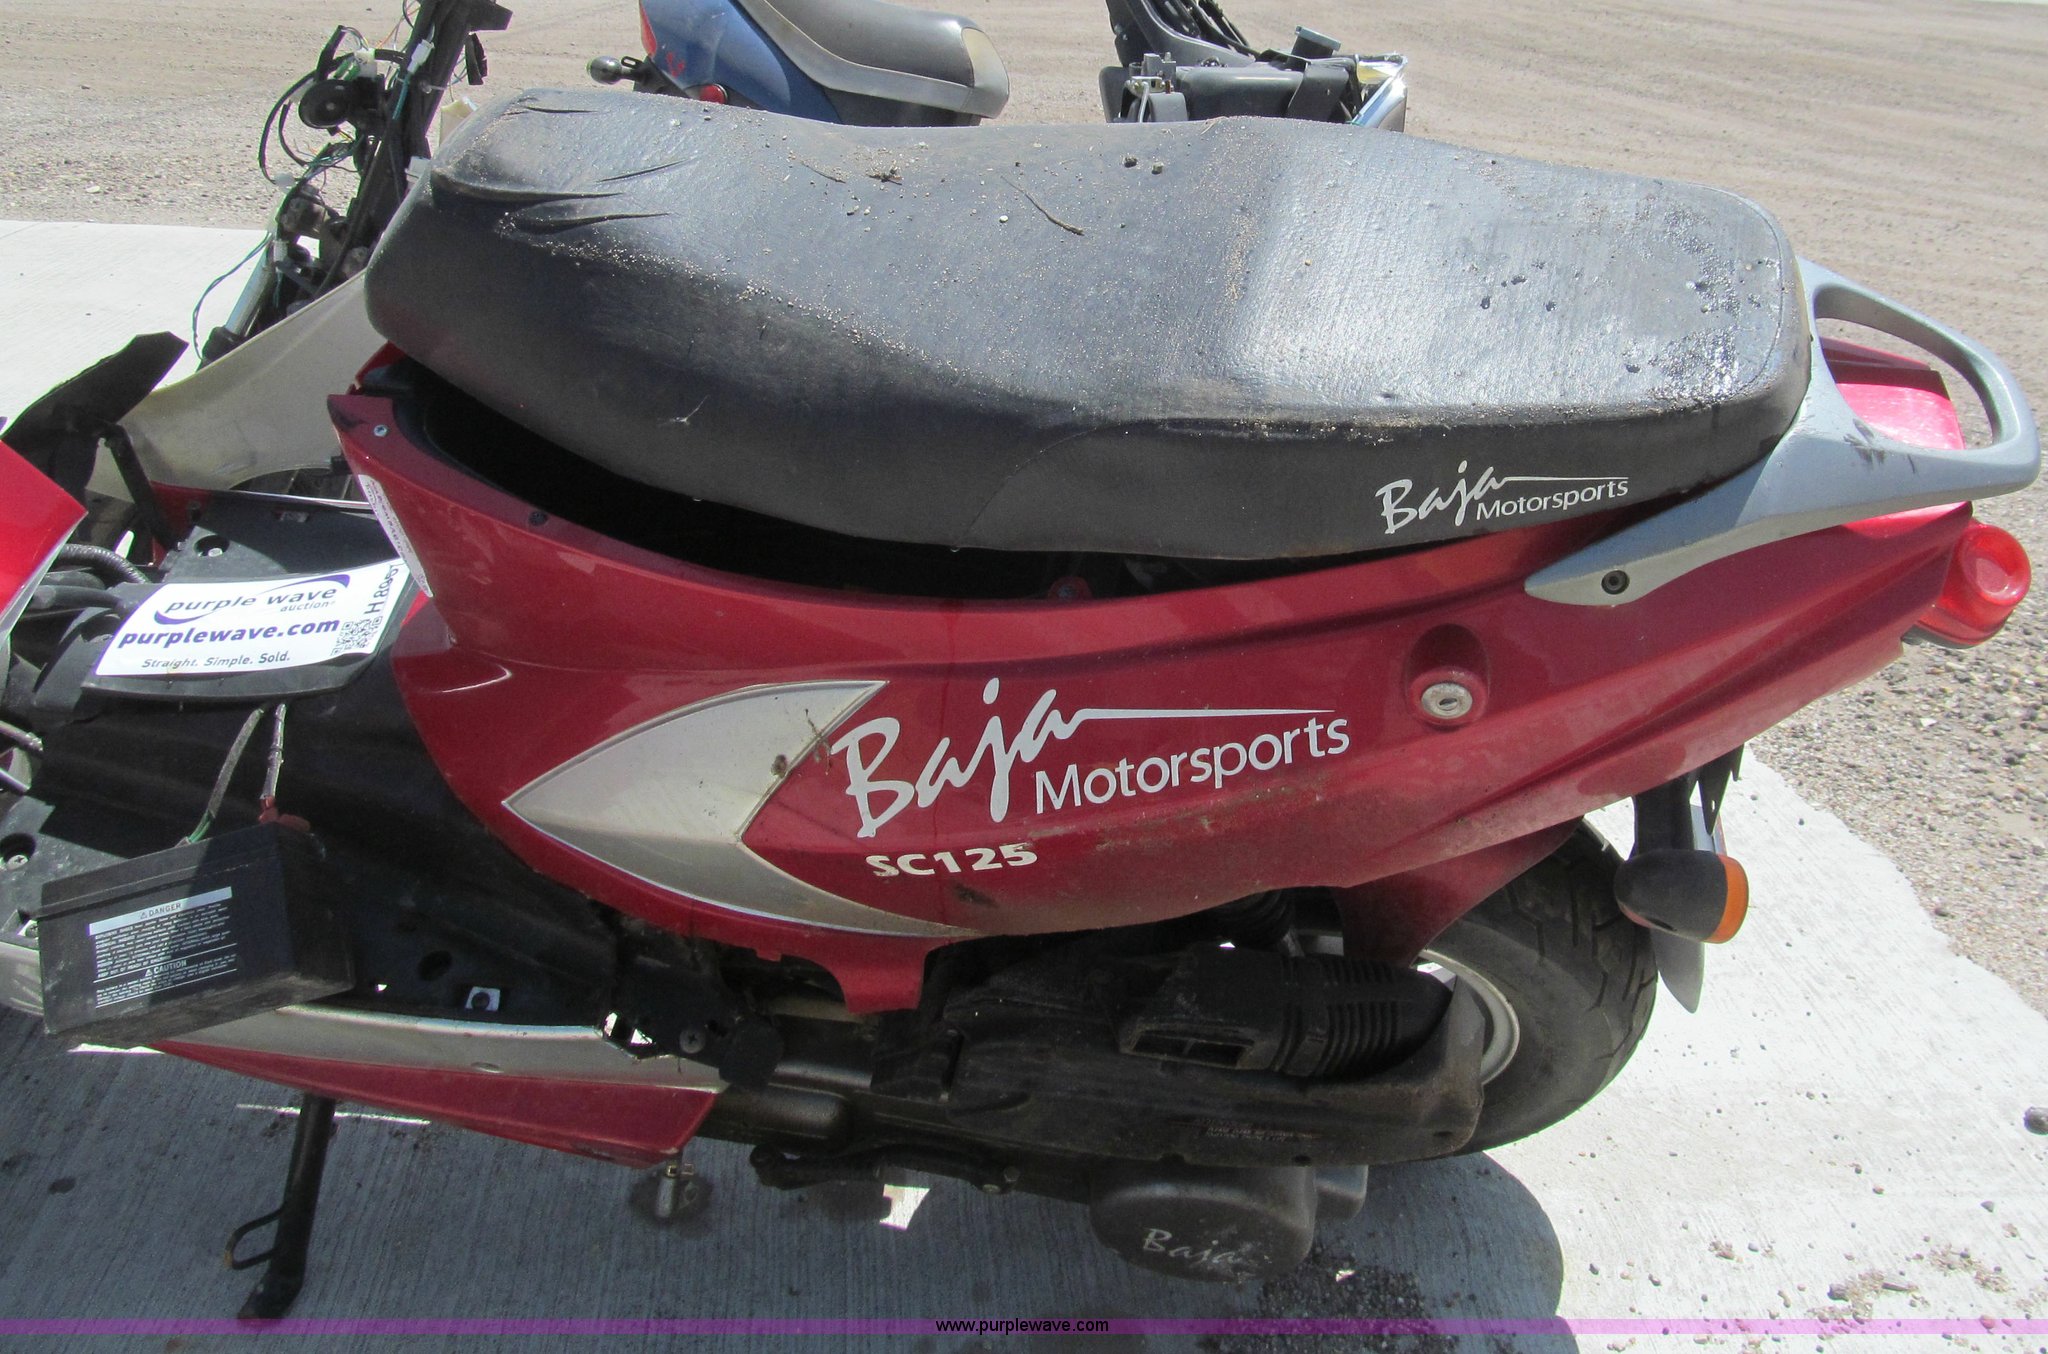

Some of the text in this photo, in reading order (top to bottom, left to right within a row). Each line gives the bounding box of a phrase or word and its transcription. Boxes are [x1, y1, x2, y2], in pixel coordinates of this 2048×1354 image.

[1375, 460, 1629, 534] Baja
[1476, 480, 1629, 520] Motorsports
[164, 588, 337, 613] purple wave
[280, 601, 329, 613] auction
[117, 619, 341, 649] purplewave.com
[141, 651, 290, 669] Straight. Simple. Sold.
[831, 678, 1335, 838] Baja
[1034, 717, 1350, 814] Motorsports
[865, 842, 1038, 877] SC125
[148, 902, 182, 918] DANGER
[153, 959, 187, 975] CAUTION
[1142, 1228, 1241, 1268] Baja
